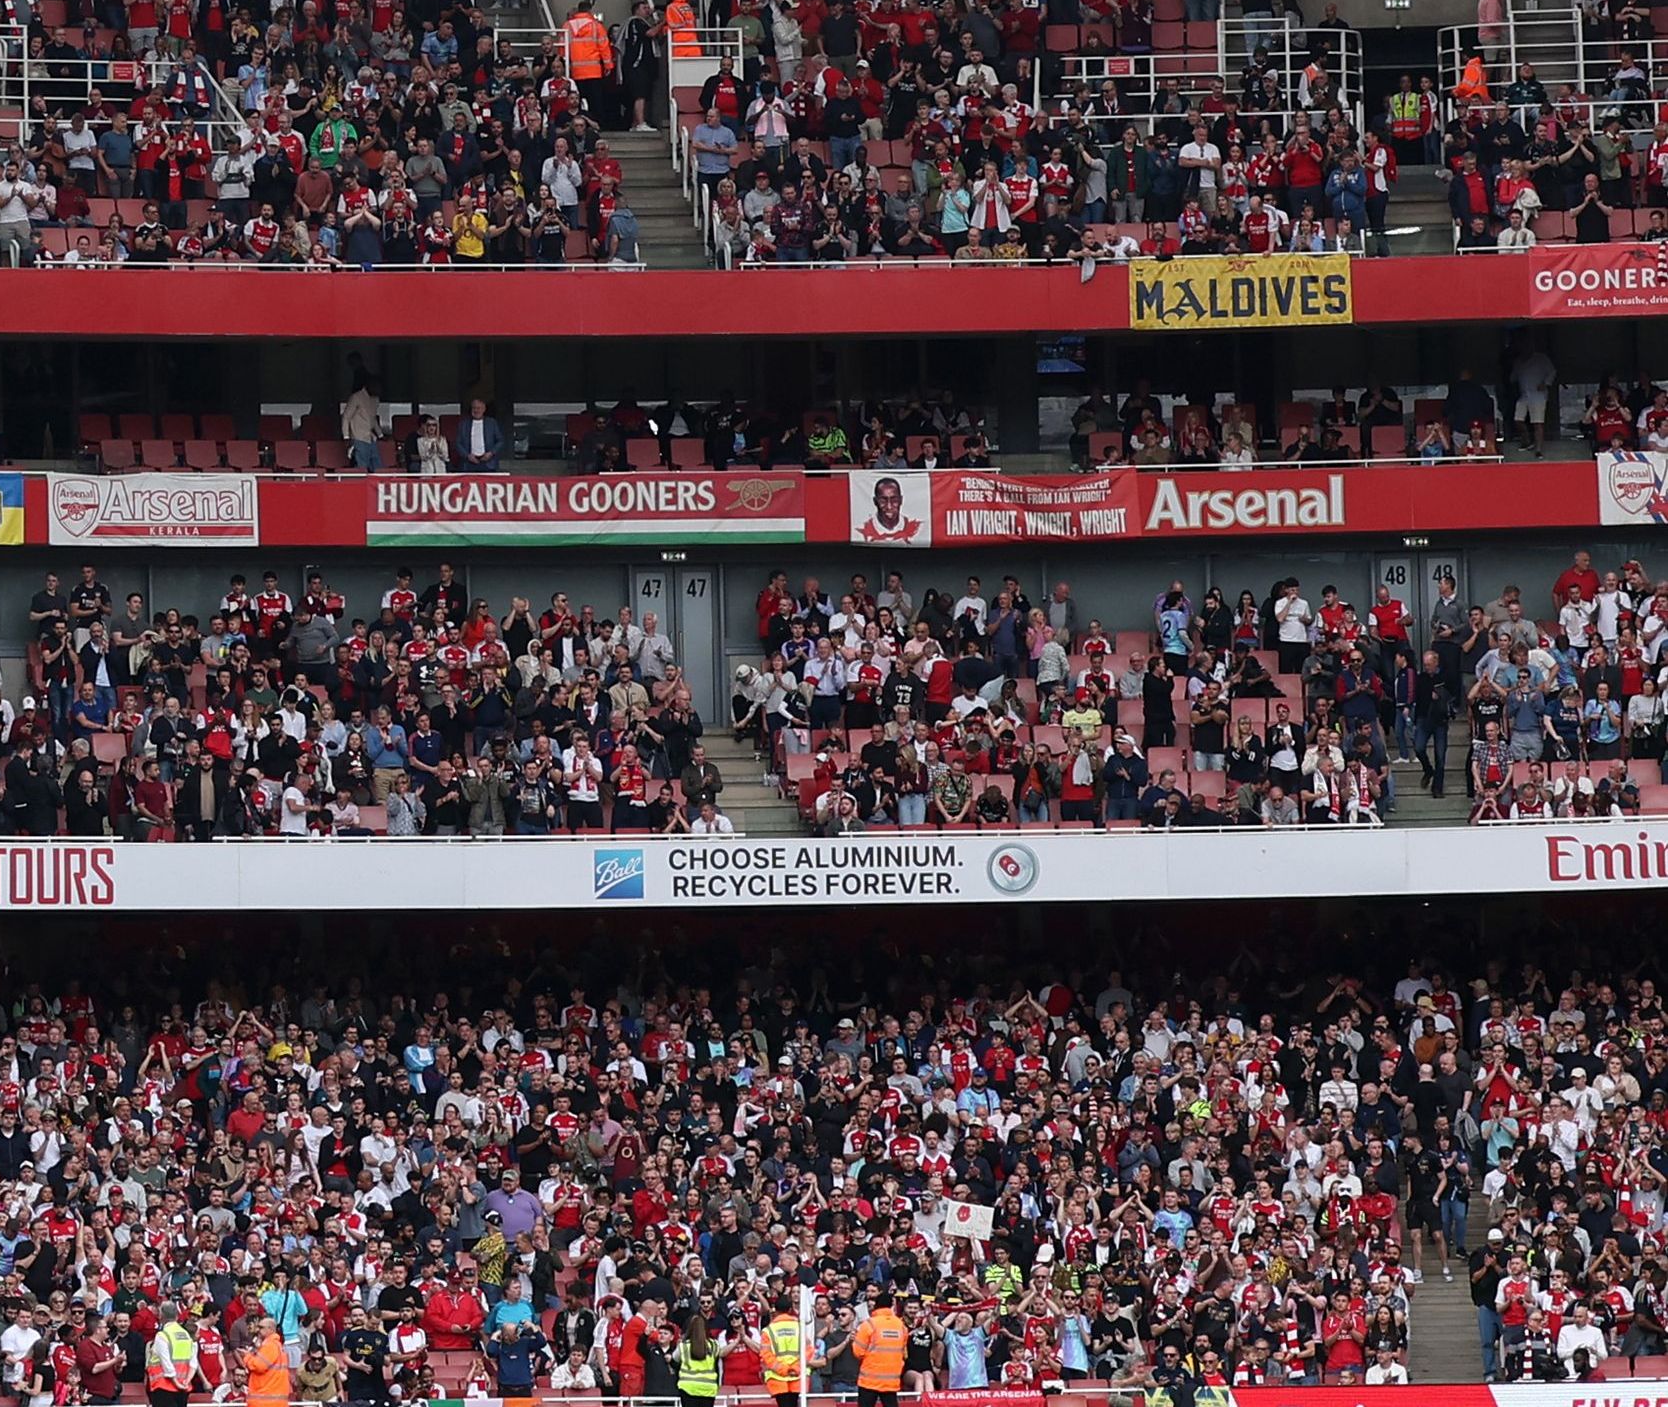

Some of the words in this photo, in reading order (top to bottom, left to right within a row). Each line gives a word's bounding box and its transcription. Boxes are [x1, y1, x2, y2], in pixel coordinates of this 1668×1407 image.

[1535, 267, 1657, 292] GOONER
[1135, 274, 1347, 325] MALDIVES
[1567, 298, 1585, 308] Eat,
[1586, 297, 1612, 308] sleep,
[1612, 295, 1649, 306] breathe,
[100, 478, 254, 522] Arsenal
[376, 479, 558, 514] HUNGARIAN
[568, 479, 716, 512] GOONERS
[1027, 491, 1053, 504] FROM
[1054, 490, 1072, 504] IAN
[1144, 473, 1348, 530] Arsenal
[149, 525, 201, 536] KERALA
[946, 510, 968, 535] IAN
[970, 510, 1022, 535] WRIGHT,
[1024, 510, 1077, 537] WRIGHT,
[1079, 508, 1126, 535] WRIGHT
[1385, 563, 1406, 586] 48
[1432, 564, 1453, 583] 48
[641, 578, 663, 599] 47
[686, 578, 707, 598] 47
[896, 691, 912, 704] 73
[668, 847, 787, 871] CHOOSE
[794, 845, 964, 869] ALUMINIUM.
[596, 854, 643, 888] Ball
[672, 873, 818, 898] RECYCLES
[825, 871, 961, 896] FOREVER.
[928, 1392, 945, 1400] WE
[946, 1391, 969, 1400] ARE
[970, 1391, 994, 1399] THE
[994, 1389, 1043, 1399] ARSENAL
